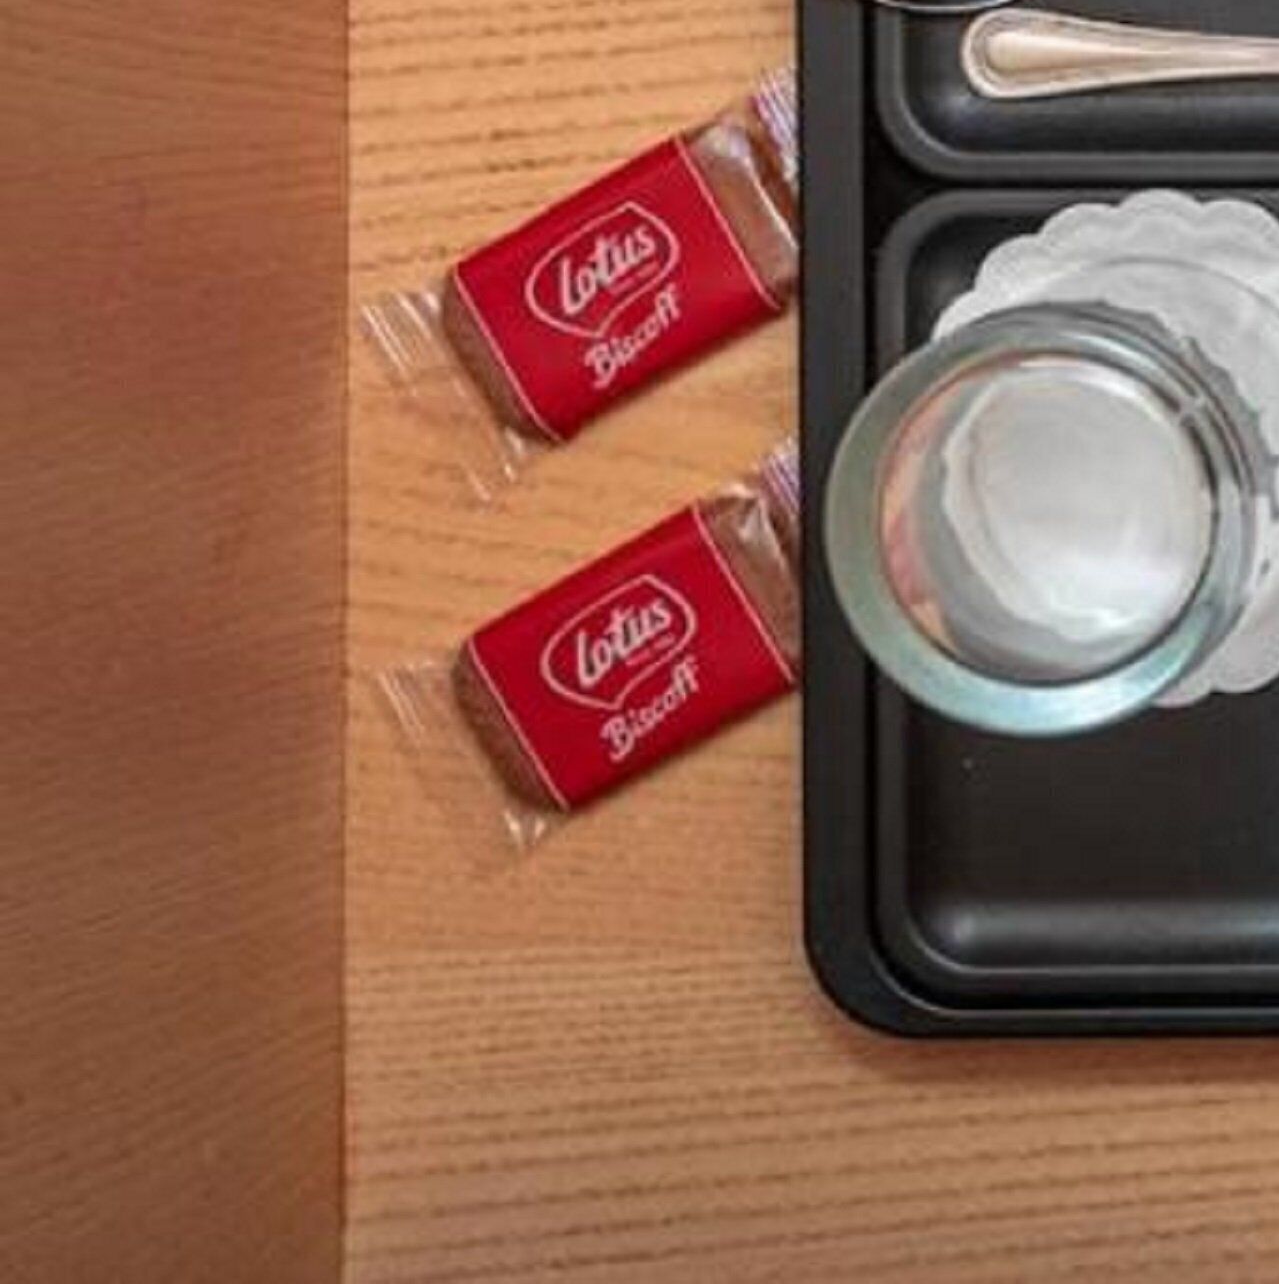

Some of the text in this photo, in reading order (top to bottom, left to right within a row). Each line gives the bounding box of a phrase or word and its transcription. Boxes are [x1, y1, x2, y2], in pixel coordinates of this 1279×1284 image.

[558, 222, 657, 316] Lotus
[584, 281, 681, 388] Biscoff
[574, 597, 673, 687] Lotus
[601, 654, 700, 764] Biscoff
